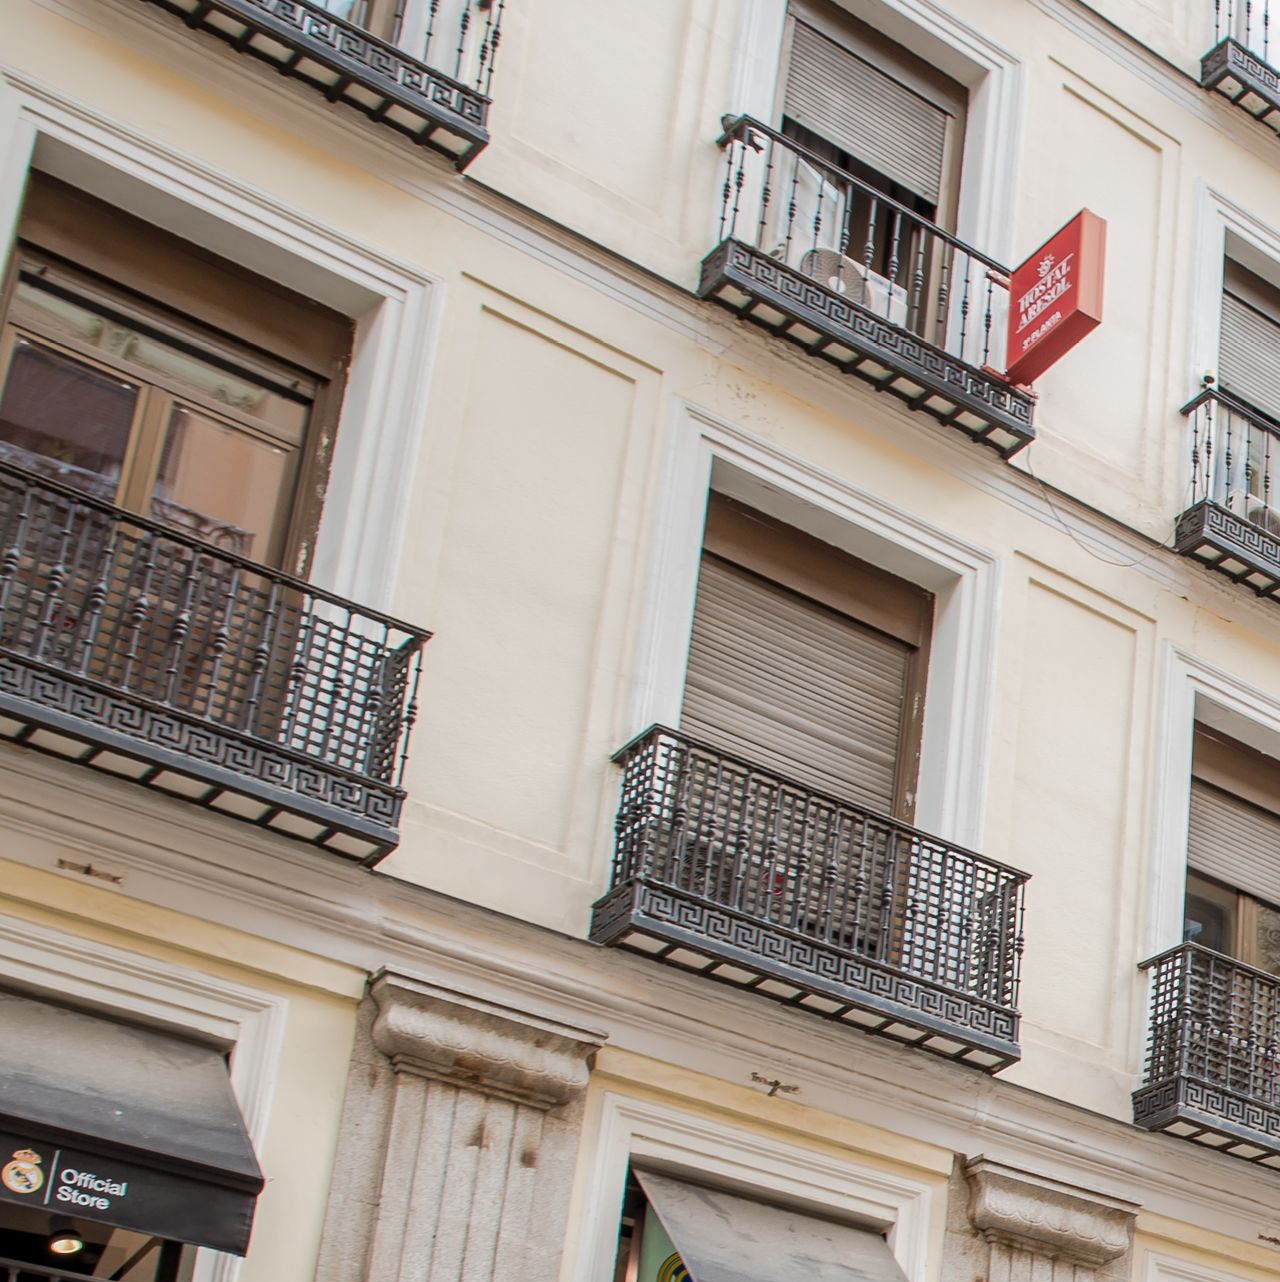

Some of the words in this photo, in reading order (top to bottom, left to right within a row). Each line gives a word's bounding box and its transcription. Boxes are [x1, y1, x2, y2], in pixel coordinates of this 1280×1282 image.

[1019, 259, 1071, 313] HOSTAL
[56, 1184, 111, 1210] Store
[60, 1168, 129, 1197] Official
